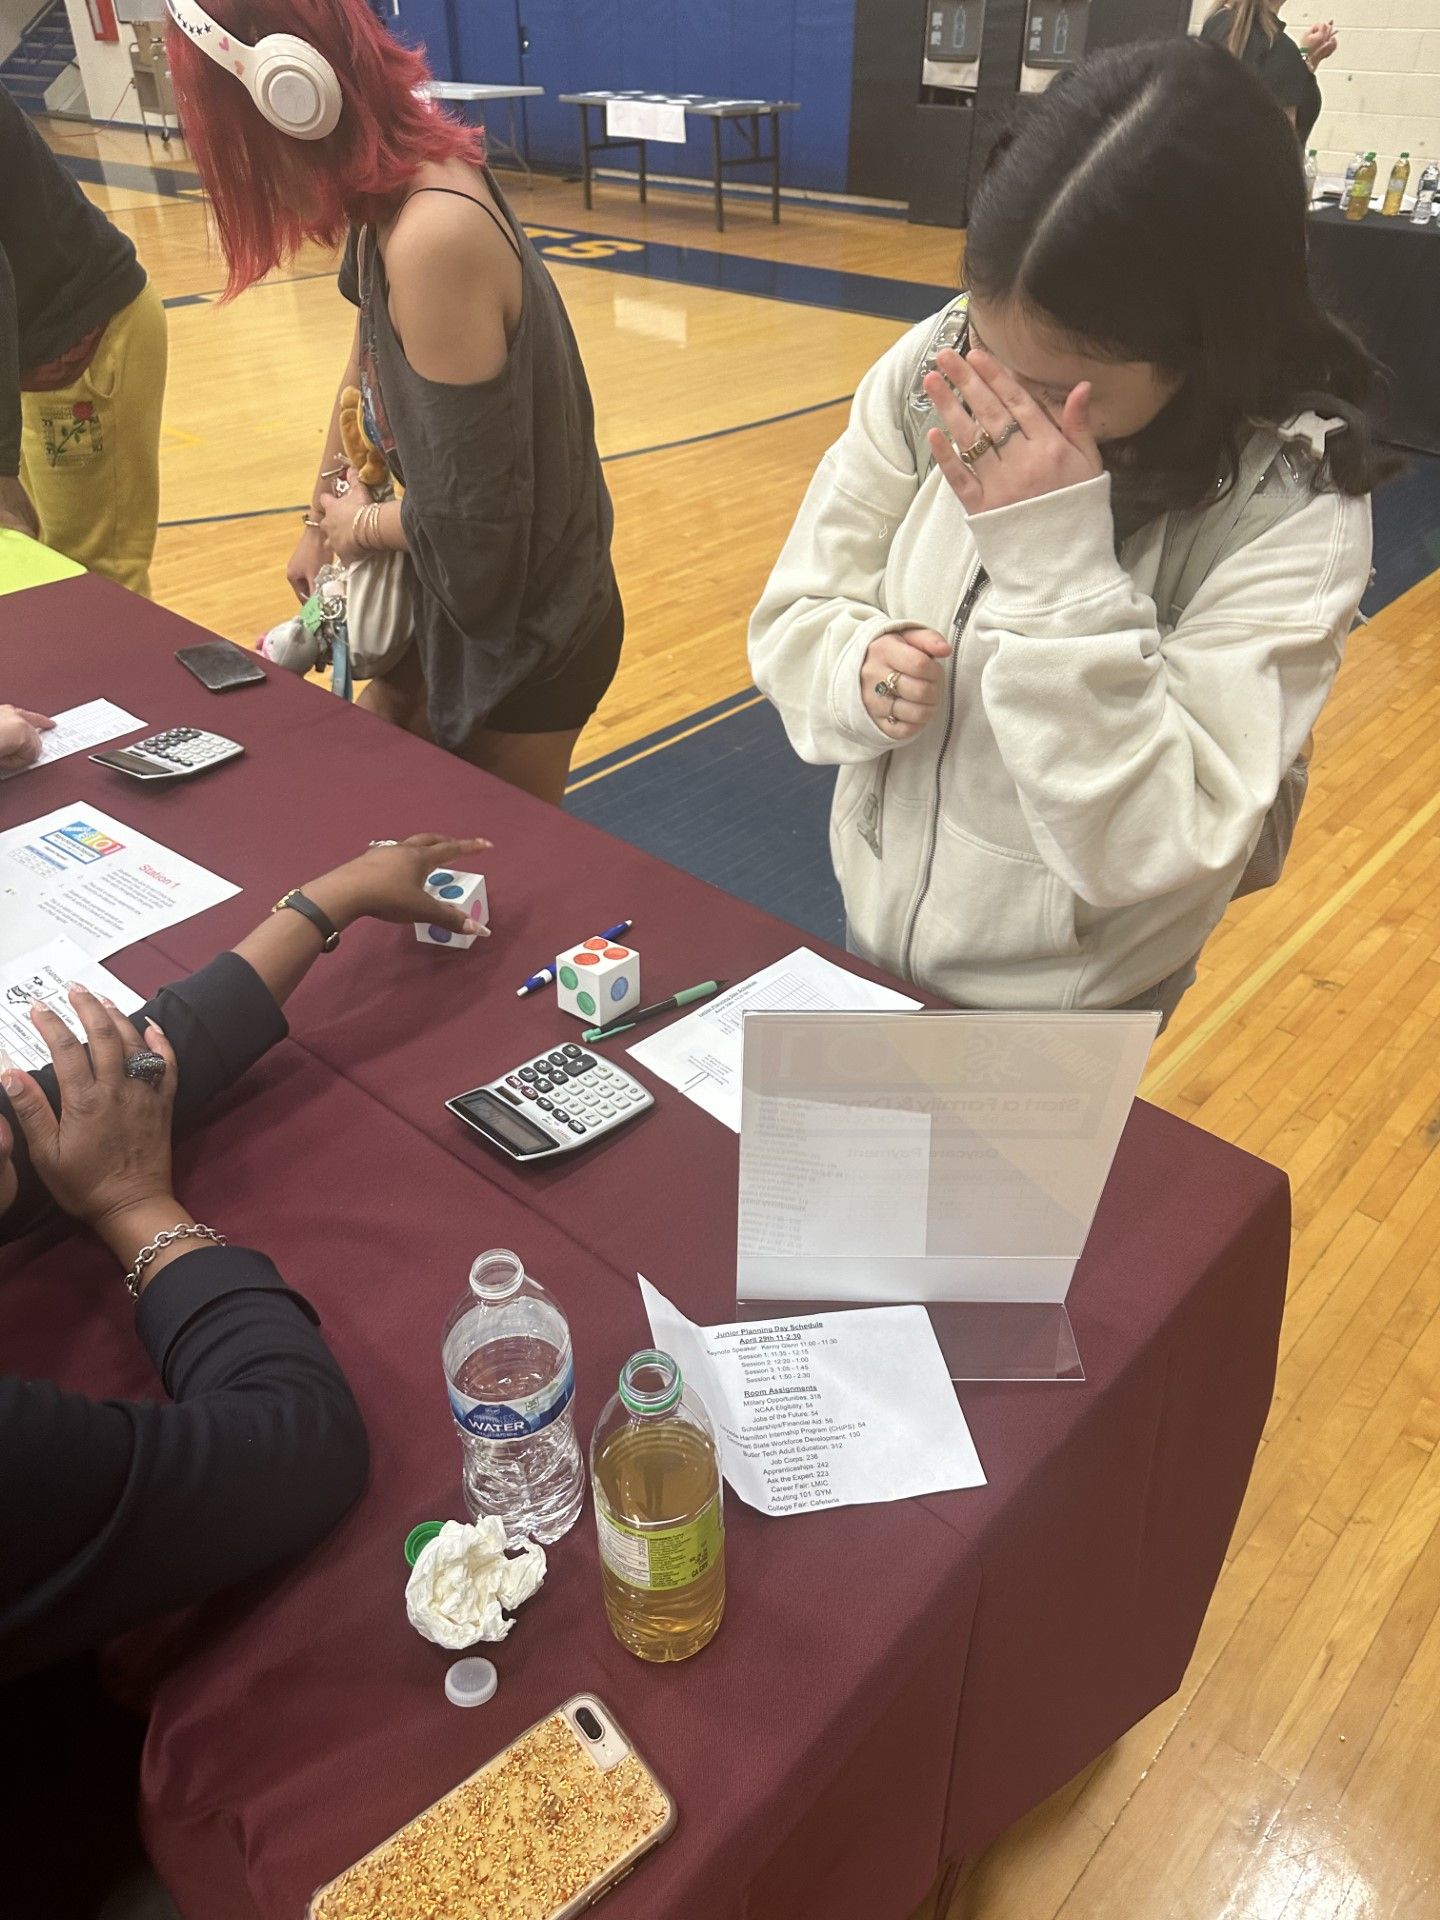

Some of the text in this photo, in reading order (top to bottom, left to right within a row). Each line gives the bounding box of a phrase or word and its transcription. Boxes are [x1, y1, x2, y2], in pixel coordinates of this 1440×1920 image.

[139, 864, 172, 885] Station
[715, 1322, 823, 1340] Junior Planning Day Schedule
[739, 1337, 757, 1346] April
[738, 1352, 763, 1360] Session
[741, 1360, 766, 1368] Session
[744, 1368, 769, 1376] Session
[746, 1376, 771, 1384] Session
[744, 1385, 818, 1398] Room Assignments
[755, 1405, 774, 1413] NCAA
[752, 1415, 767, 1423] Jobs
[769, 1413, 776, 1421] of
[776, 1412, 787, 1420] the
[467, 1418, 525, 1432] WATER
[740, 1433, 768, 1441] Hamilton
[769, 1429, 799, 1439] Internship
[801, 1426, 828, 1435] Program
[753, 1441, 770, 1449] State
[771, 1438, 803, 1447] Workforce
[763, 1449, 778, 1457] Tech
[779, 1447, 795, 1455] Adult
[780, 1475, 791, 1483] the
[816, 1470, 829, 1478] 223
[770, 1485, 794, 1493] Career
[771, 1493, 798, 1502] Adulting
[815, 1488, 832, 1496] GYM
[767, 1503, 793, 1512] College
